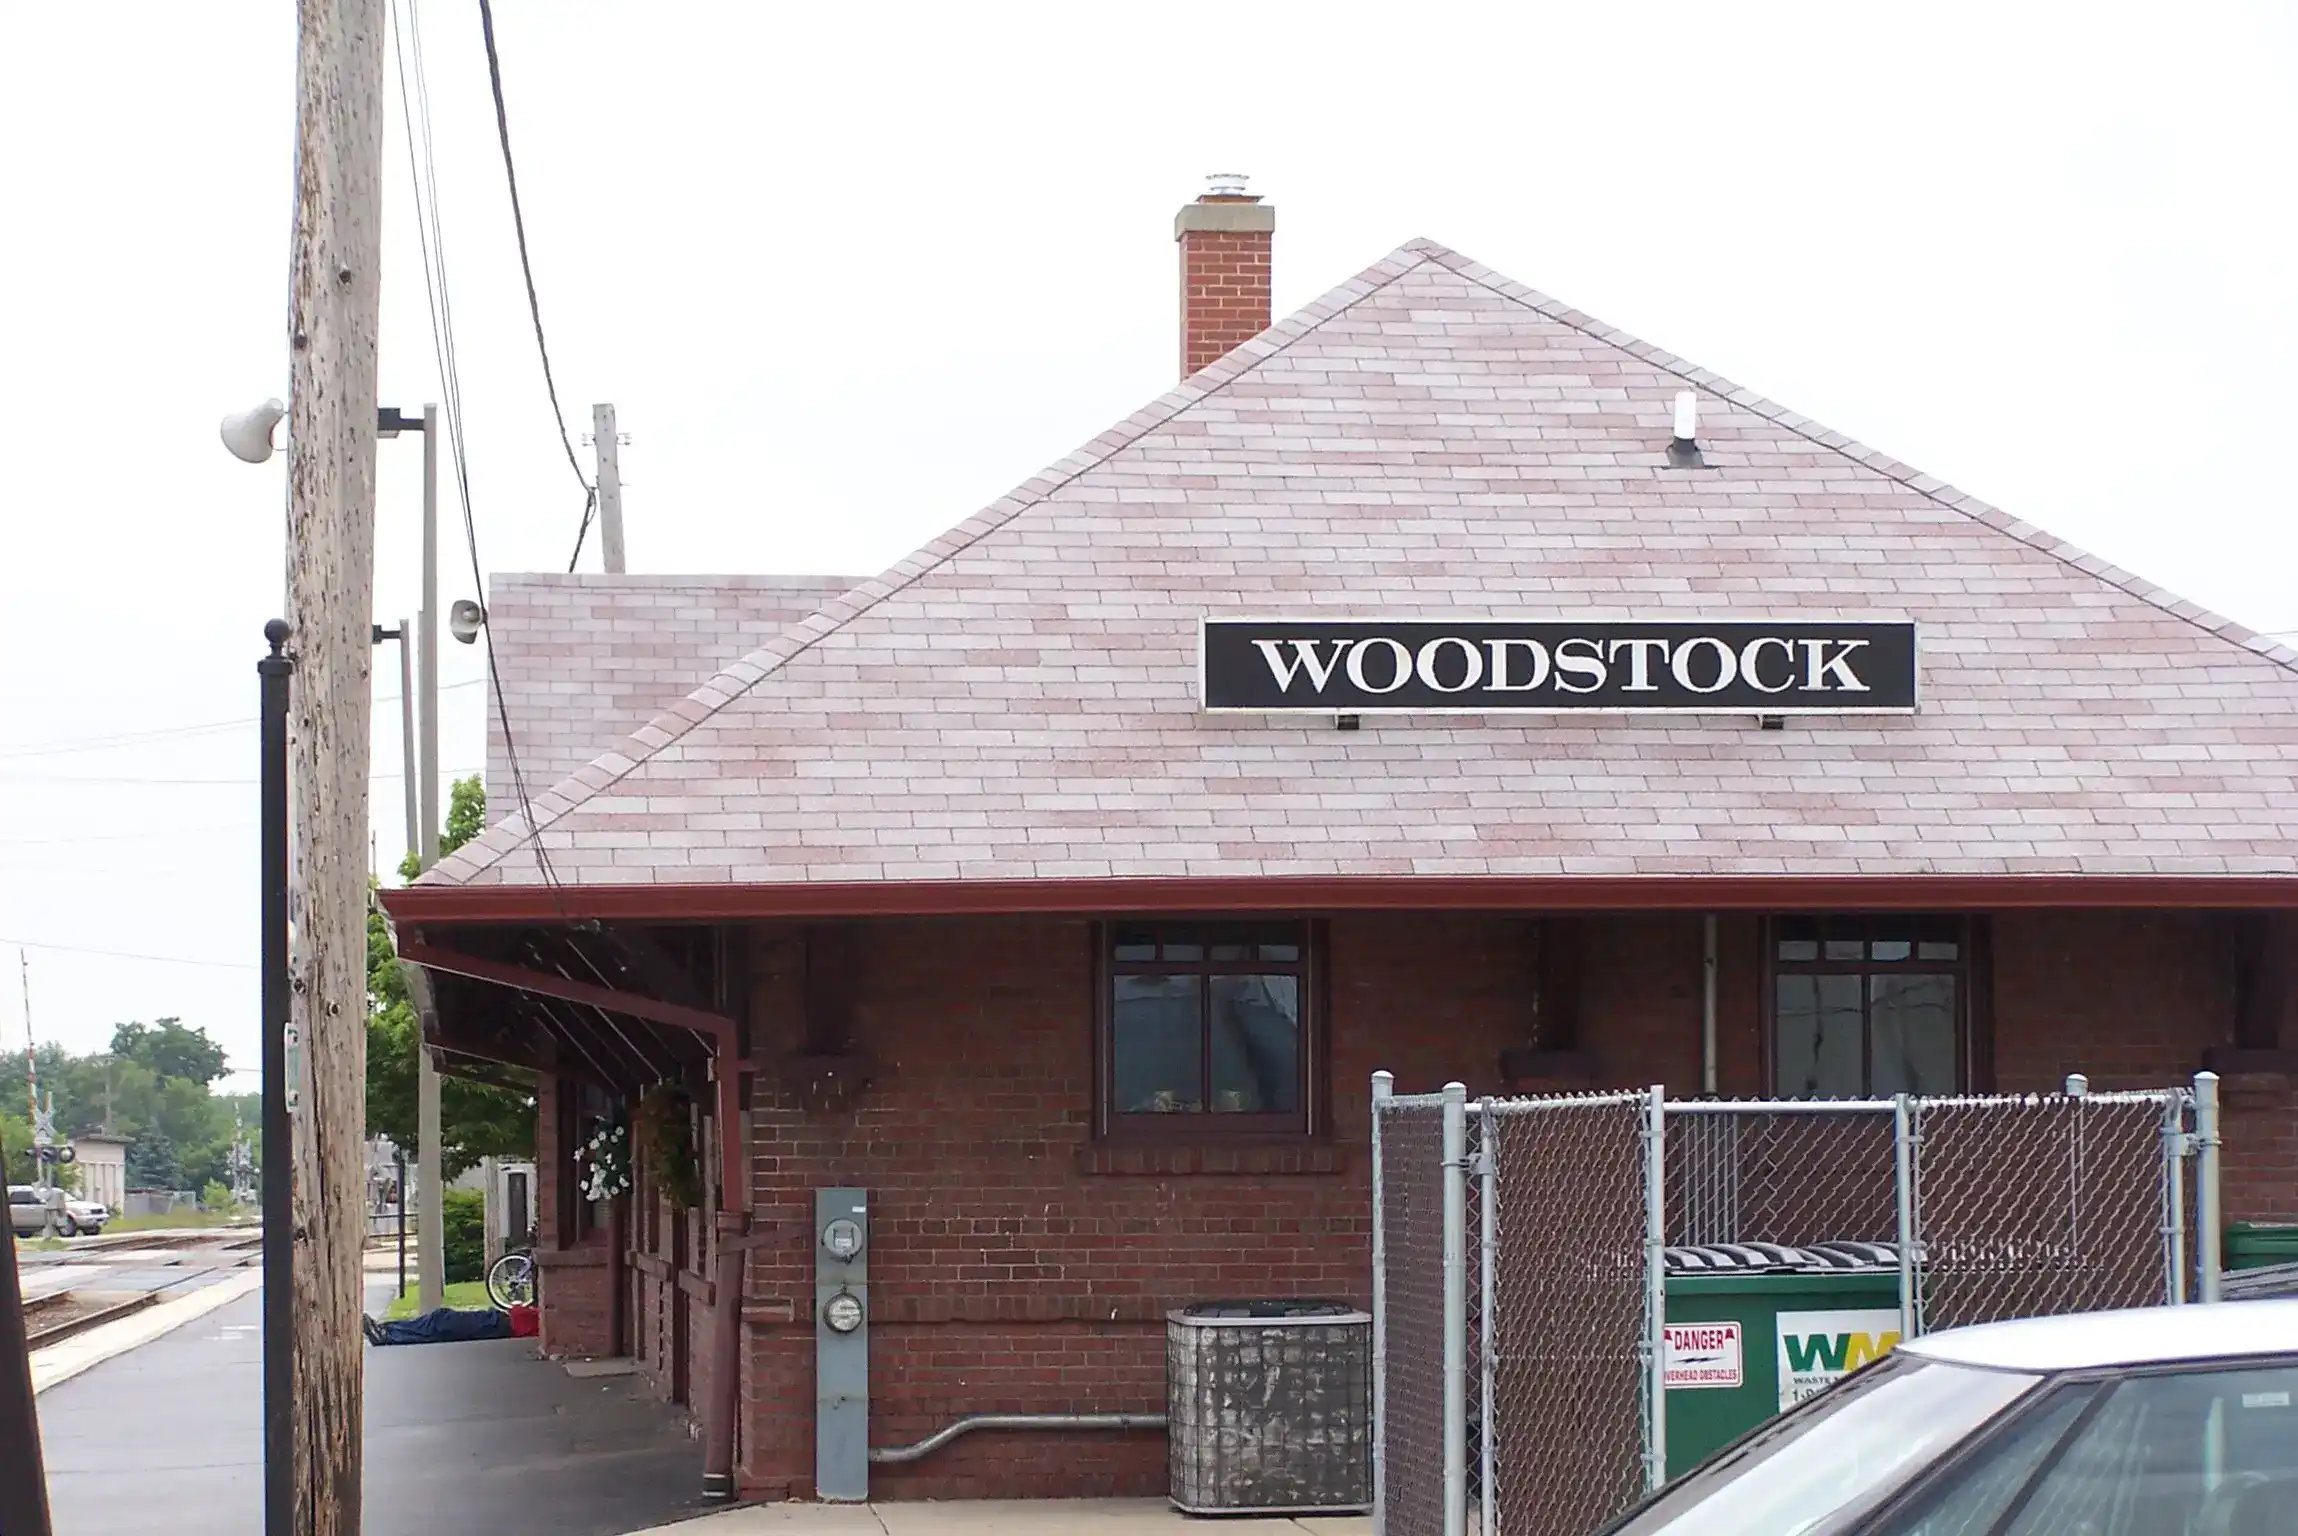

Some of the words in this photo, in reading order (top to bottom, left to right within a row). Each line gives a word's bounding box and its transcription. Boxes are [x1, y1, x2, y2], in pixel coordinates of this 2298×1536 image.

[1251, 637, 1871, 694] WOODSTOCK
[1674, 1329, 1724, 1351] DANGER
[1783, 1332, 1902, 1372] WM
[1664, 1369, 1698, 1381] VERHEAD
[1699, 1368, 1737, 1381] OBSTACLES
[1793, 1375, 1832, 1386] WASTE
